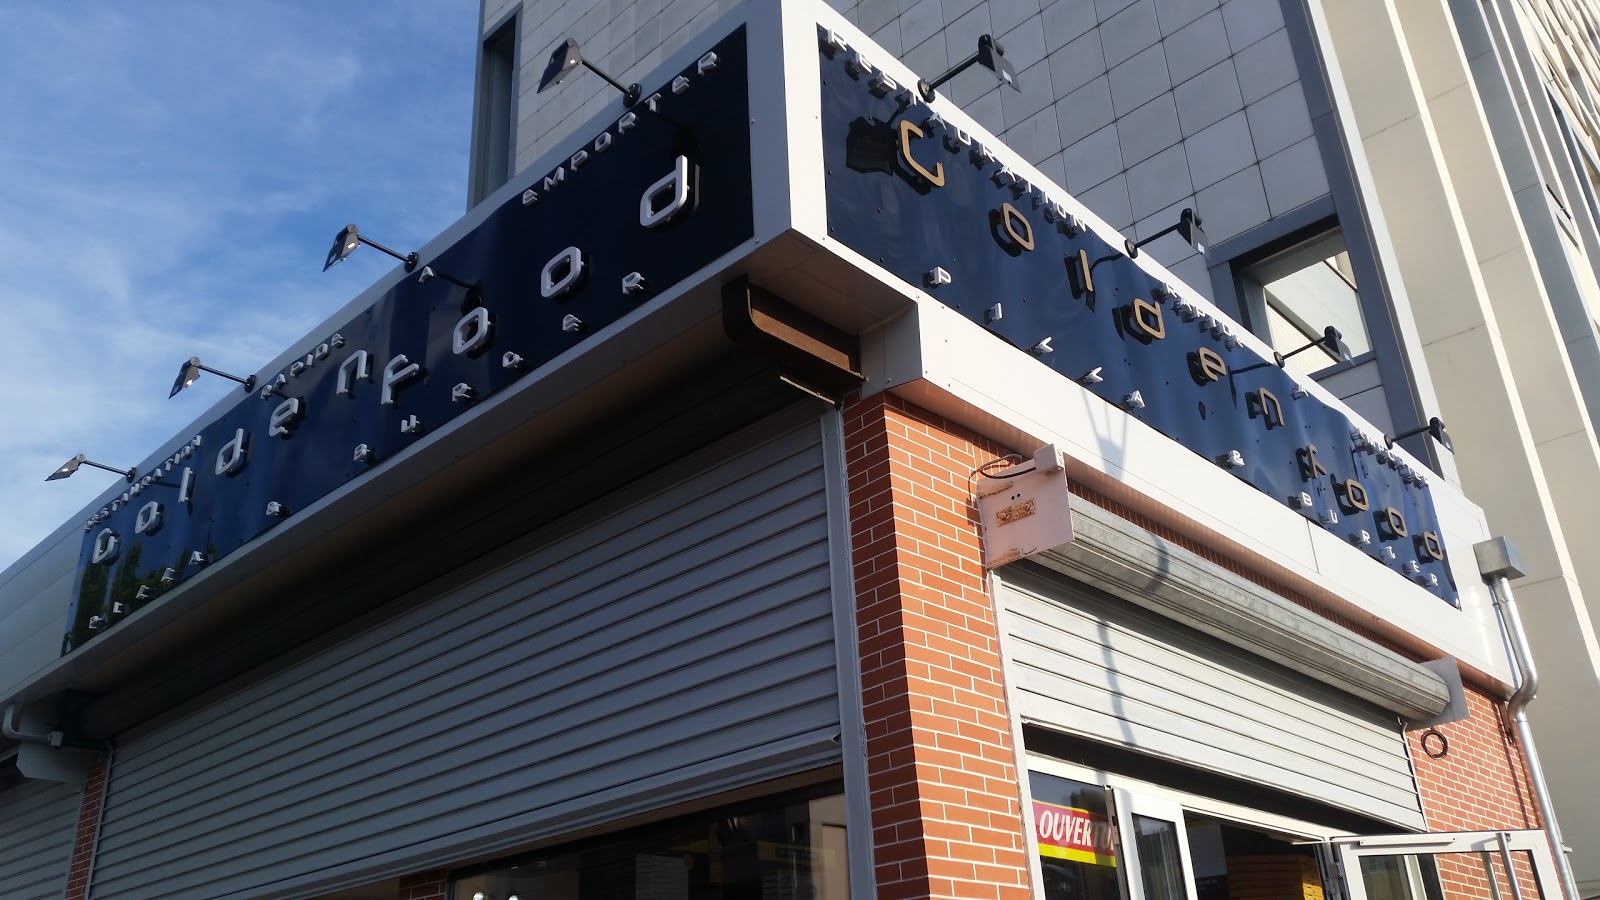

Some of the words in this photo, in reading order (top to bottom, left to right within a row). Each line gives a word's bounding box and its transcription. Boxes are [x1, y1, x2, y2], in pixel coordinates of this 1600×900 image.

[83, 434, 201, 533] RESTAURATION
[260, 333, 345, 400] RAPIDE
[418, 265, 434, 283] A
[522, 50, 718, 206] EMPORTER
[827, 27, 1087, 232] RESTAURATION
[1162, 281, 1243, 348] RAPIDE
[353, 271, 645, 462] BURGER
[1300, 491, 1439, 587] BURGER
